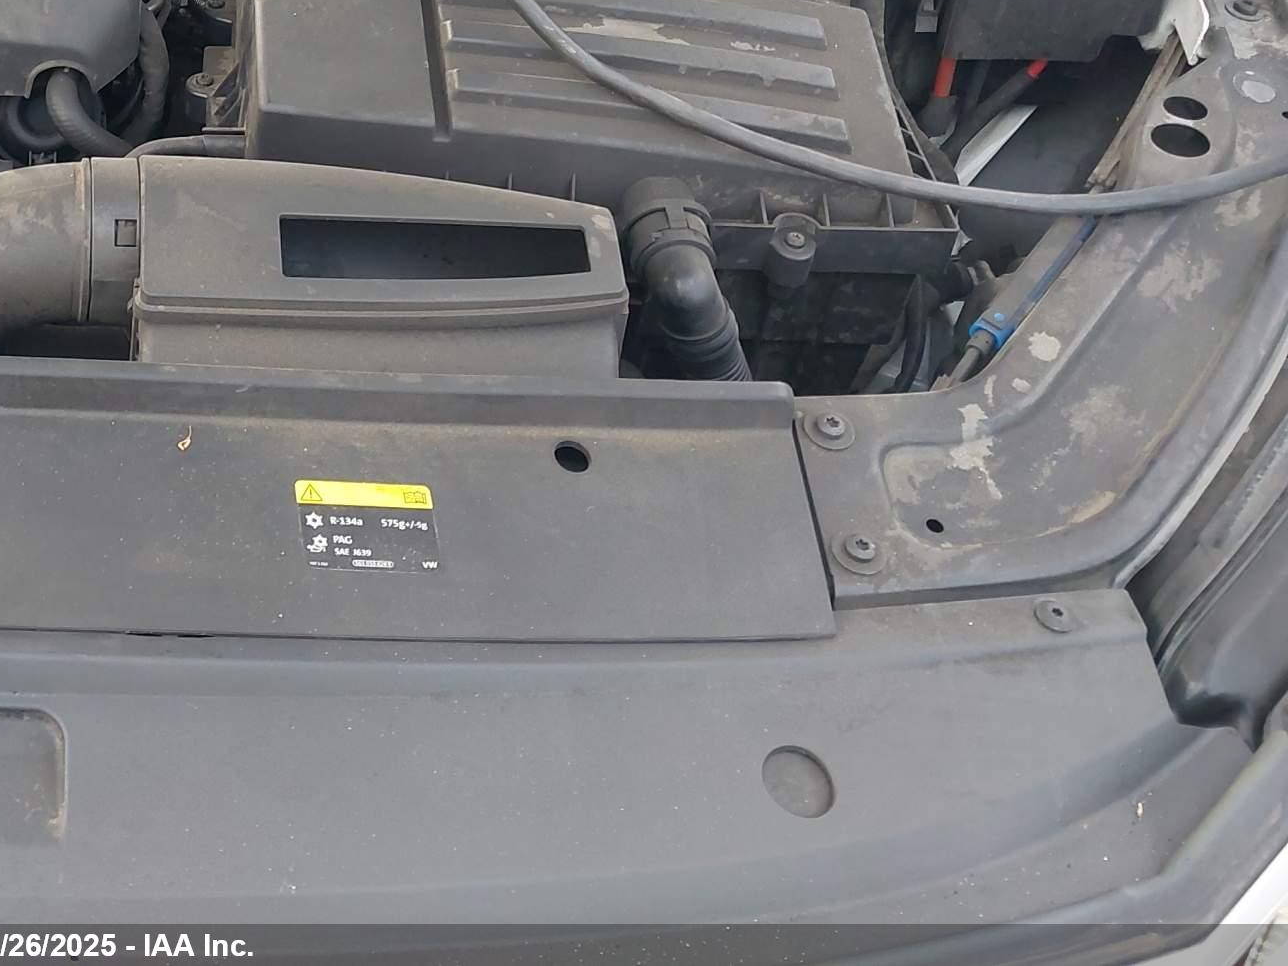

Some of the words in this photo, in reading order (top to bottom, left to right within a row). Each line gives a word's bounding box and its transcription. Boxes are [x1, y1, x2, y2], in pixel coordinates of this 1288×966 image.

[329, 516, 364, 526] R-134a
[332, 534, 353, 545] PAG
[334, 547, 350, 556] SAE
[421, 561, 438, 569] VW
